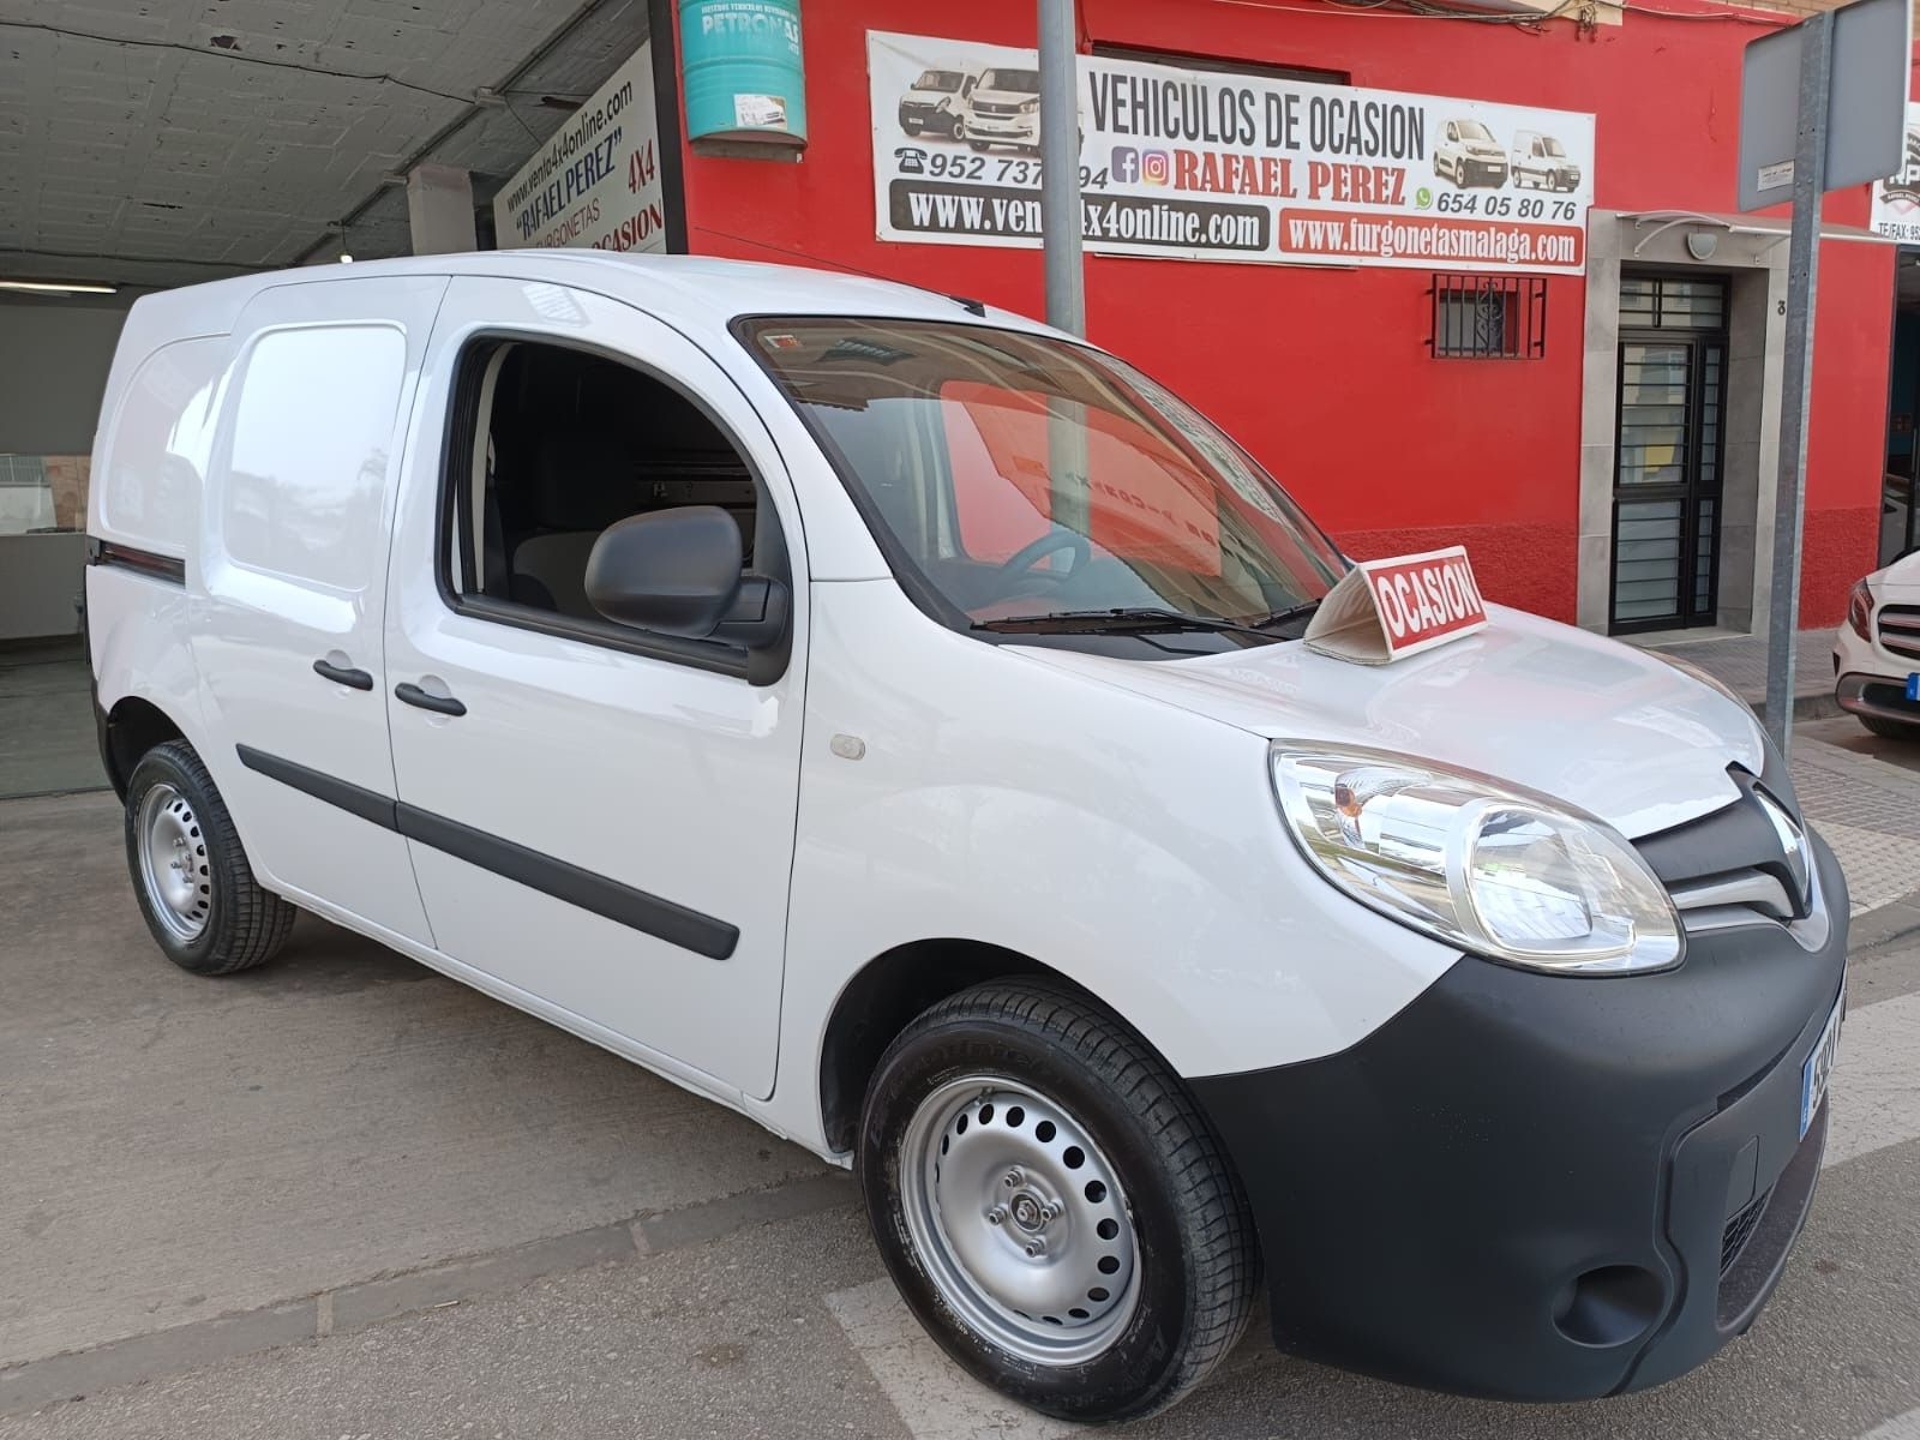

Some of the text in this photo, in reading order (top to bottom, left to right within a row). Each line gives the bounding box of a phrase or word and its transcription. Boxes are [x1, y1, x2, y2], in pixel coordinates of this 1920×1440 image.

[1089, 71, 1425, 160] VEHICULOS DE OCASION
[628, 138, 655, 194] 4X4
[928, 153, 1109, 190] 952 737 94
[1174, 149, 1406, 206] RAFAEL PEREZ
[536, 197, 600, 248] RGONETAS
[592, 199, 663, 252] CASION
[908, 192, 1260, 246] www.venx4online.com
[1437, 192, 1577, 221] 654 05 80 76
[1910, 225, 1920, 241] 95
[1288, 217, 1576, 263] www.furgonetasmalaga.com
[1377, 562, 1481, 638] OCASION
